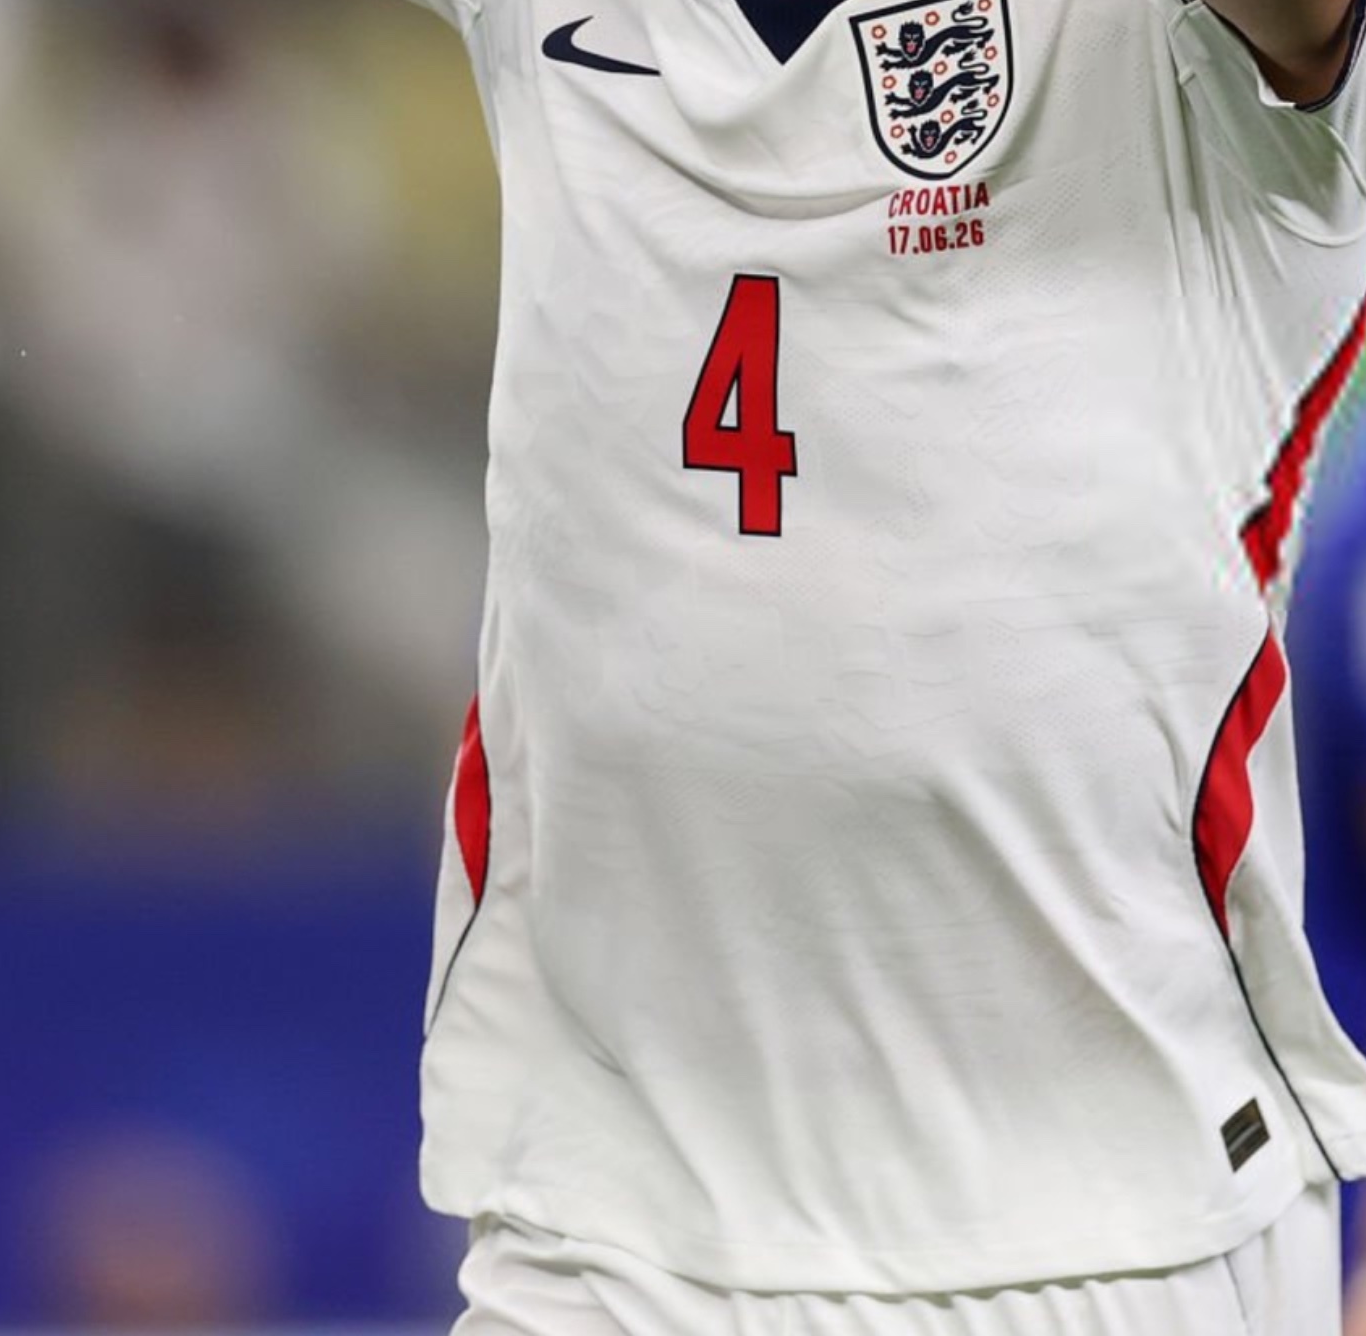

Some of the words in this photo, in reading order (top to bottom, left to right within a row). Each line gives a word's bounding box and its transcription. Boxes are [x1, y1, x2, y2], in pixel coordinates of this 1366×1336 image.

[887, 181, 990, 219] CROATIA
[887, 219, 984, 255] 17.06.26
[682, 273, 798, 537] 4
